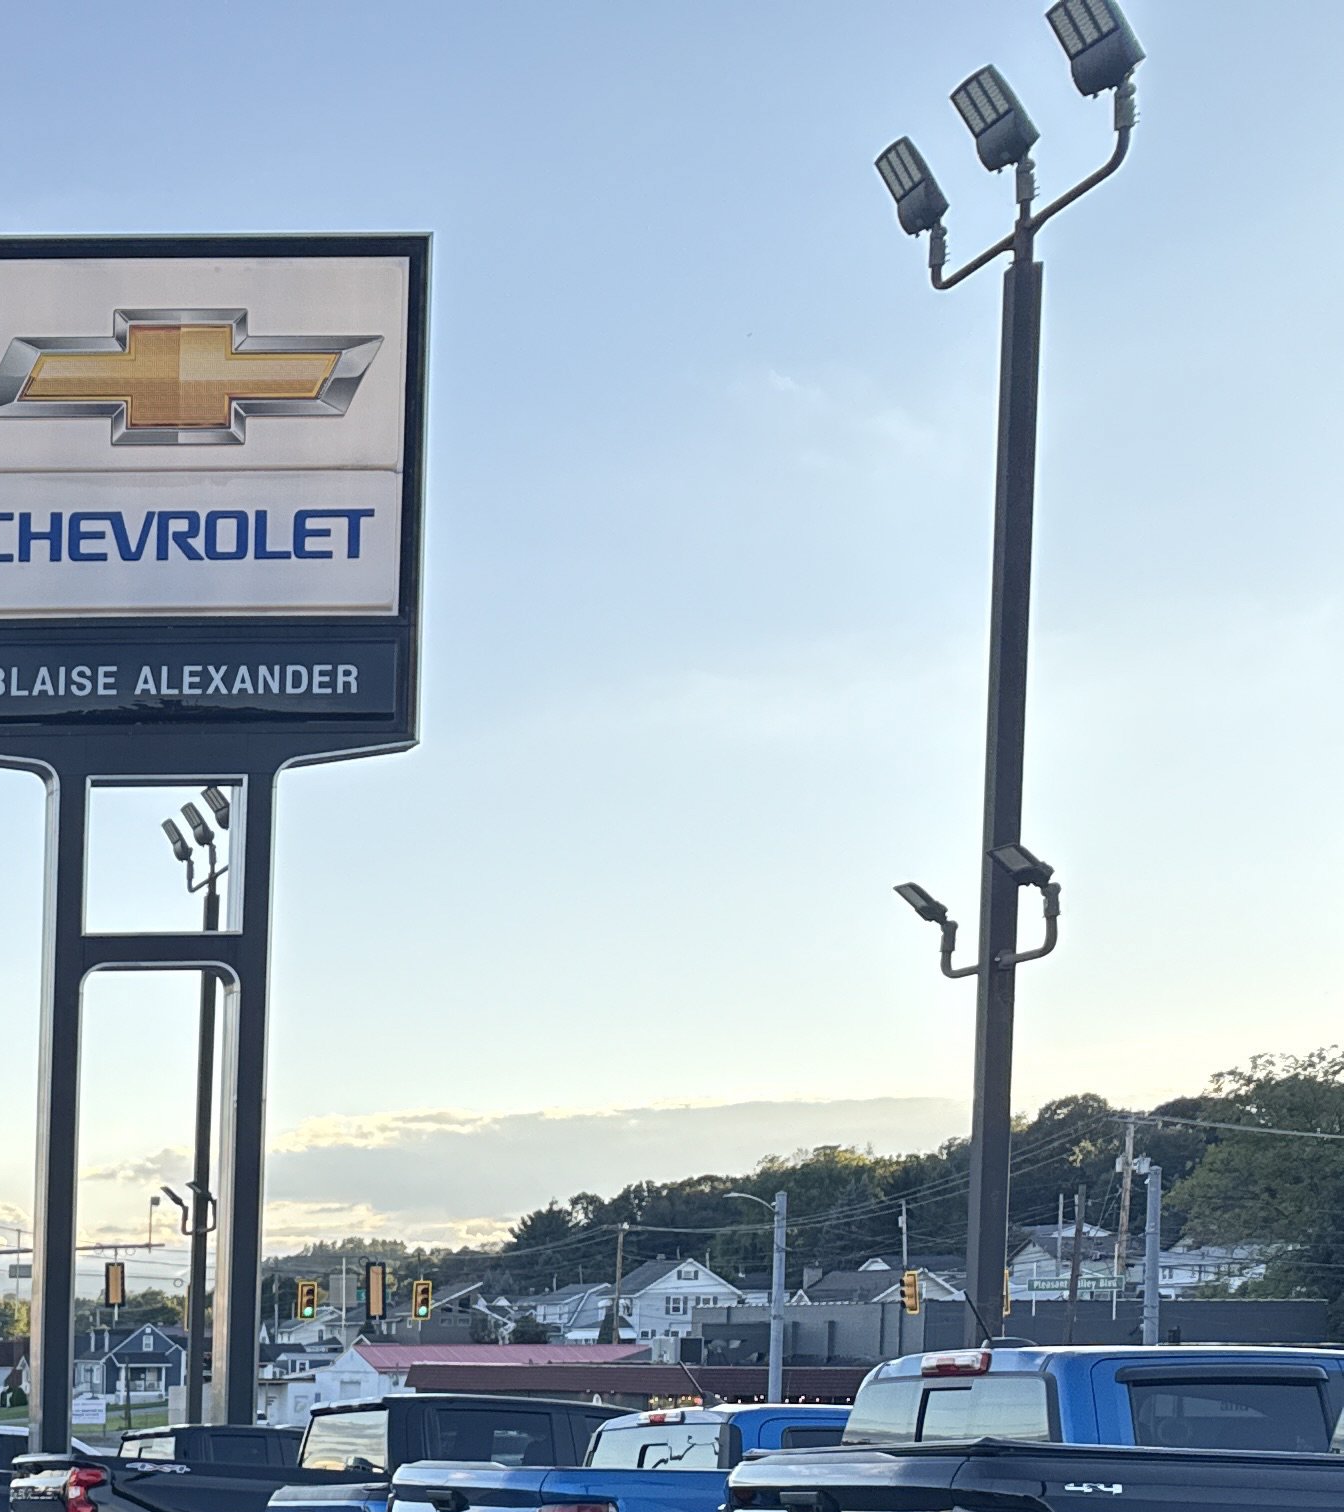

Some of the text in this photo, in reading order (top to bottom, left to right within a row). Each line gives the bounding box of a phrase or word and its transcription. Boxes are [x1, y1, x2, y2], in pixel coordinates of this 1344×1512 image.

[134, 663, 359, 695] ALEXANDER
[1033, 1279, 1068, 1289] Pleasant
[1077, 1278, 1097, 1290] lley
